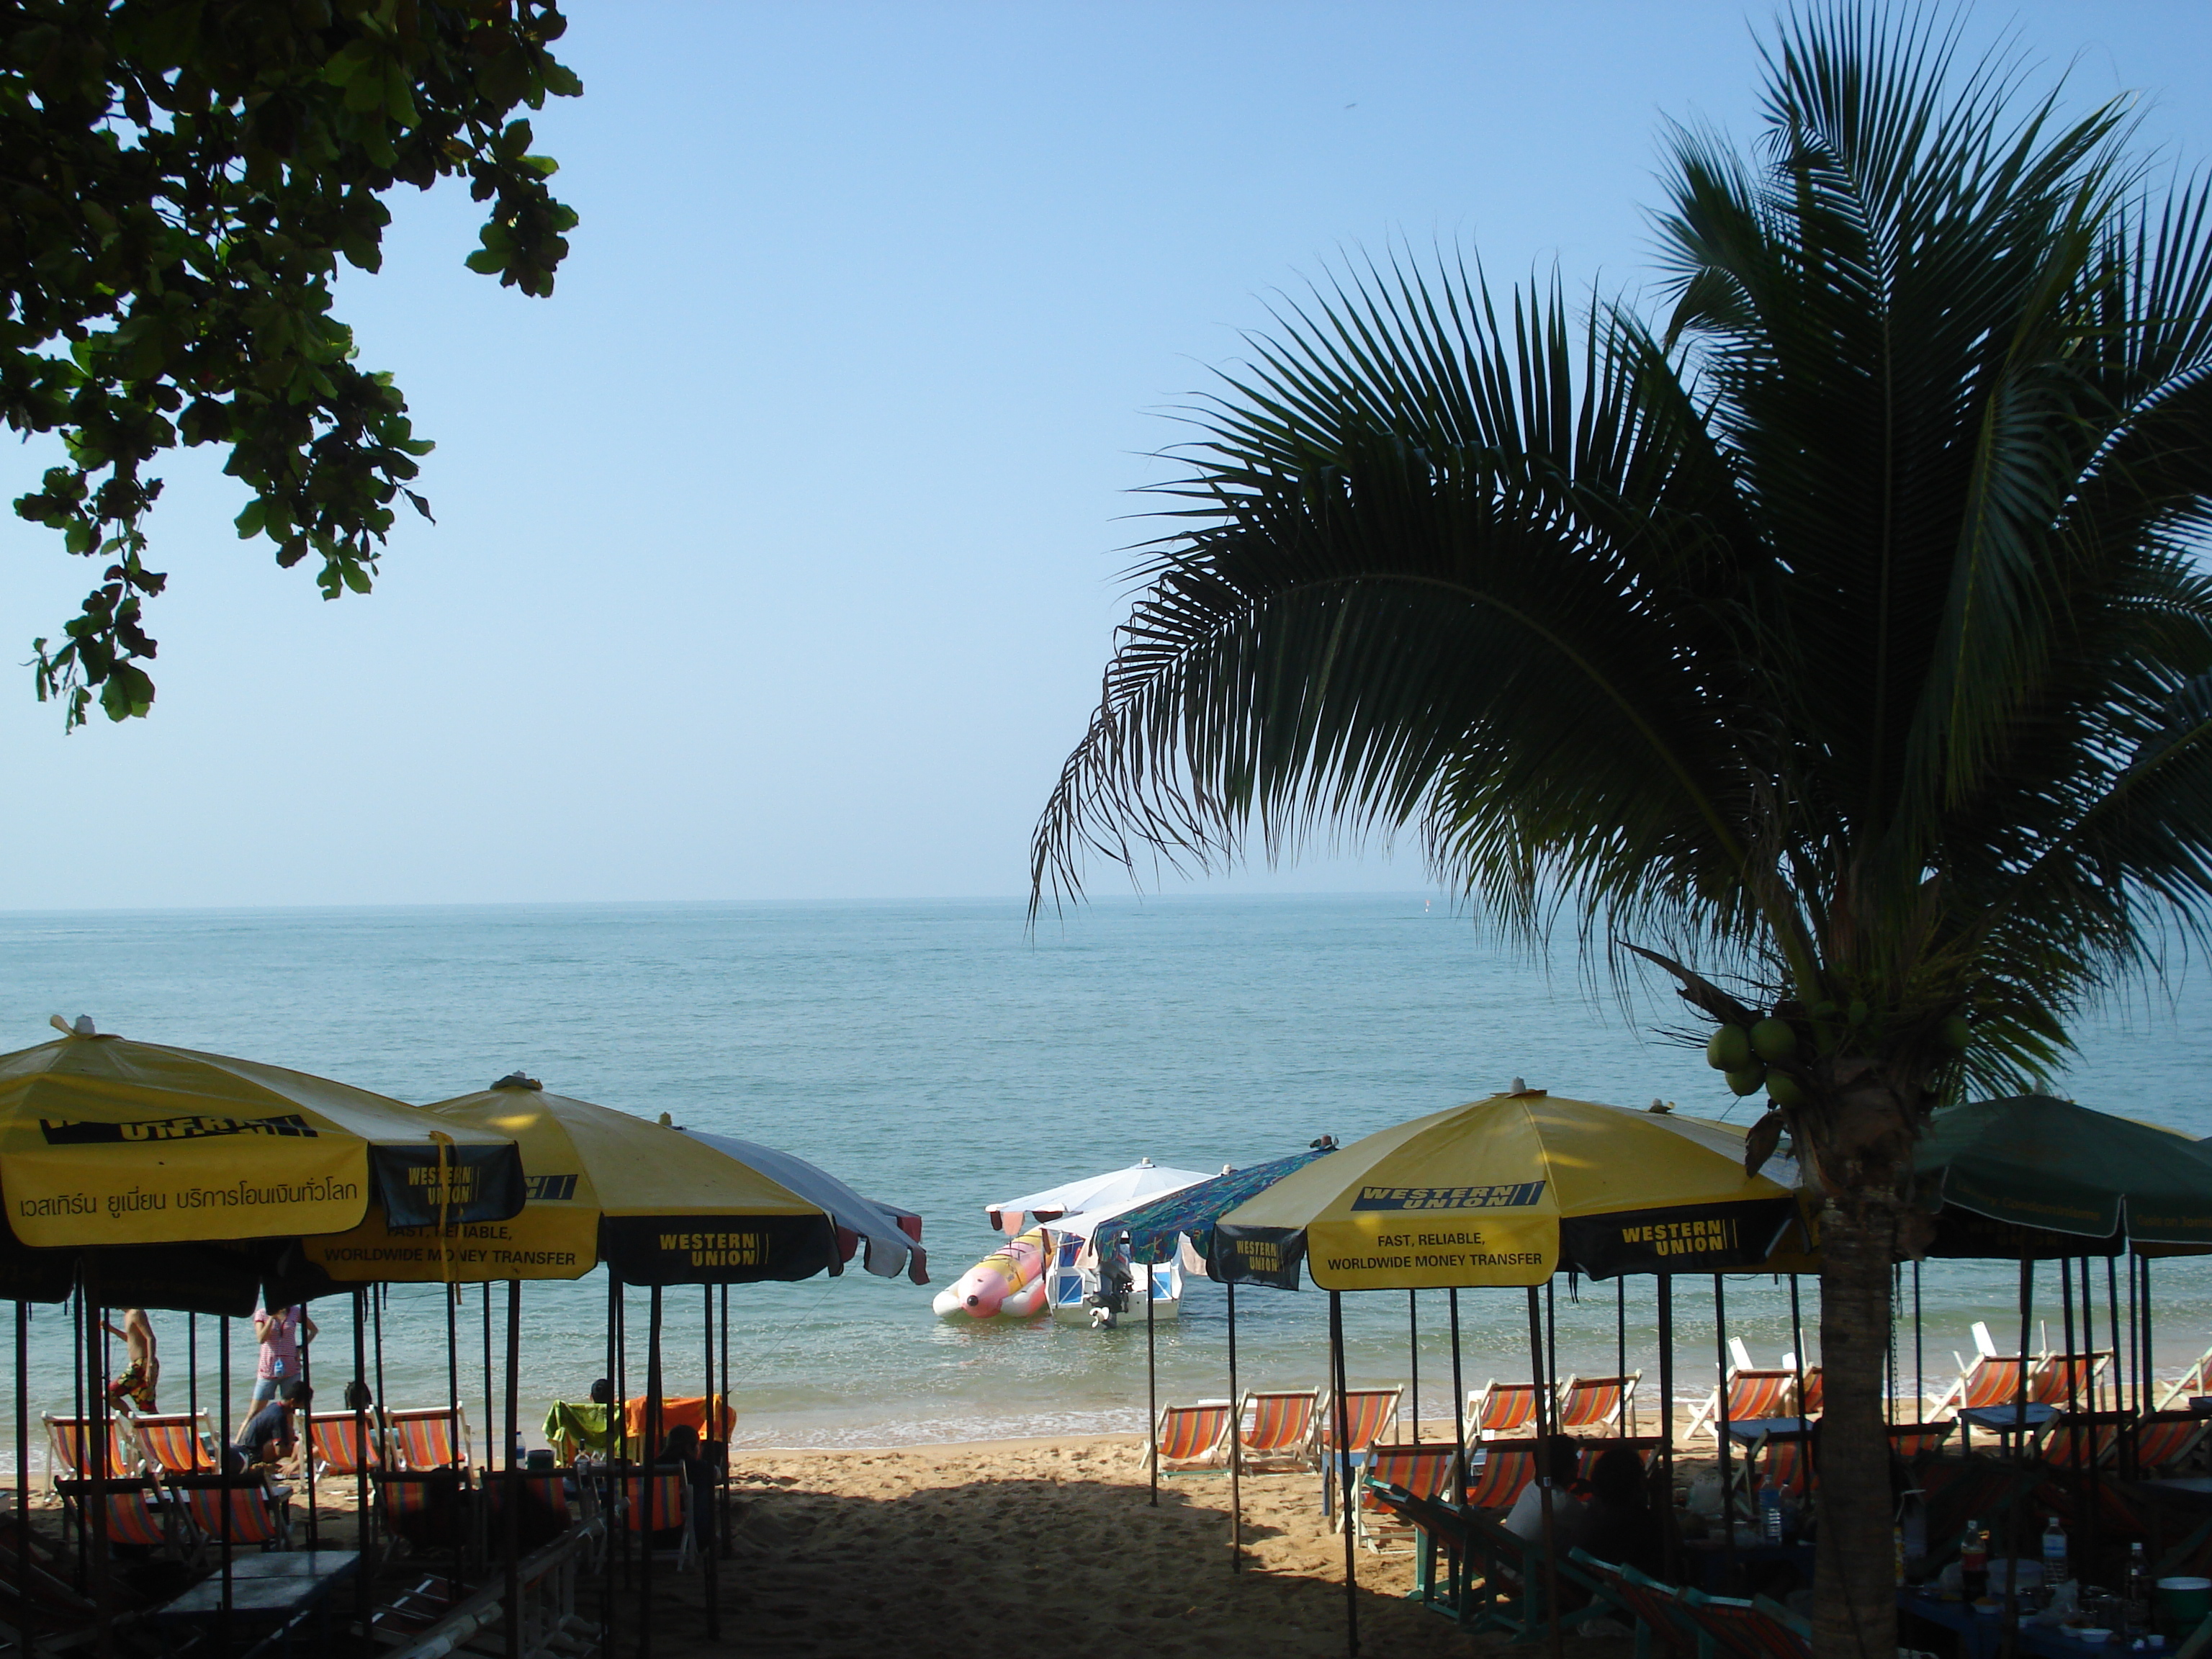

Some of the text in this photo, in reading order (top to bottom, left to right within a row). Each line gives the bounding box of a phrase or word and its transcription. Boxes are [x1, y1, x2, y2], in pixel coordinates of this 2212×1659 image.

[1363, 1185, 1514, 1200] WESTERN
[20, 1192, 96, 1216] เวสเทิร์น
[108, 1186, 166, 1218] ยูเนี่ยน
[1402, 1197, 1509, 1210] UNION
[1377, 1233, 1486, 1248] FAST, RELIABLE,
[1622, 1220, 1722, 1244] WESTERN
[659, 1233, 755, 1250] WESTERN
[1236, 1240, 1277, 1257] WESTERN
[1655, 1236, 1724, 1256] UNION
[324, 1248, 575, 1266] WORLDWIDE MONEY TRANSFER
[691, 1250, 756, 1267] UNION
[1249, 1256, 1279, 1272] UNION
[1328, 1253, 1542, 1270] WORLDWIDE MONEY TRANSFER
